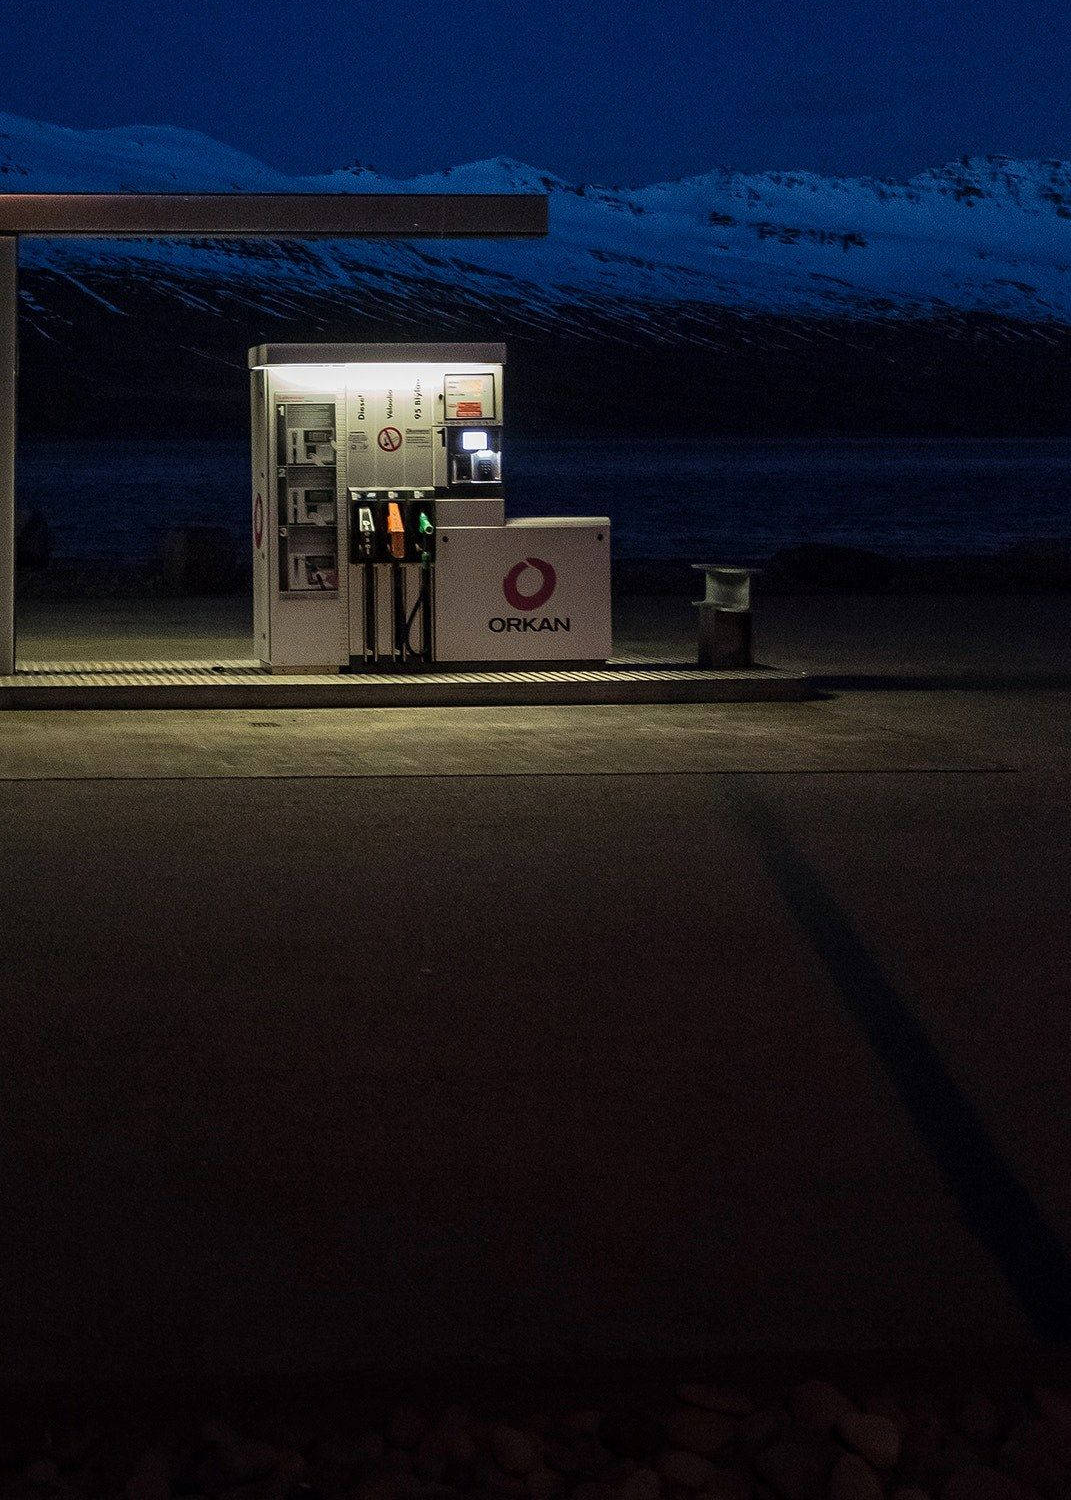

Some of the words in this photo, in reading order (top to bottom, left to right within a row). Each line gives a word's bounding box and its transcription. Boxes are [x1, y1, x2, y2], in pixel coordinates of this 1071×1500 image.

[278, 405, 285, 416] 1
[357, 395, 366, 420] Diesel
[414, 409, 421, 420] 95
[436, 428, 446, 447] 1
[488, 618, 570, 632] ORKAN
